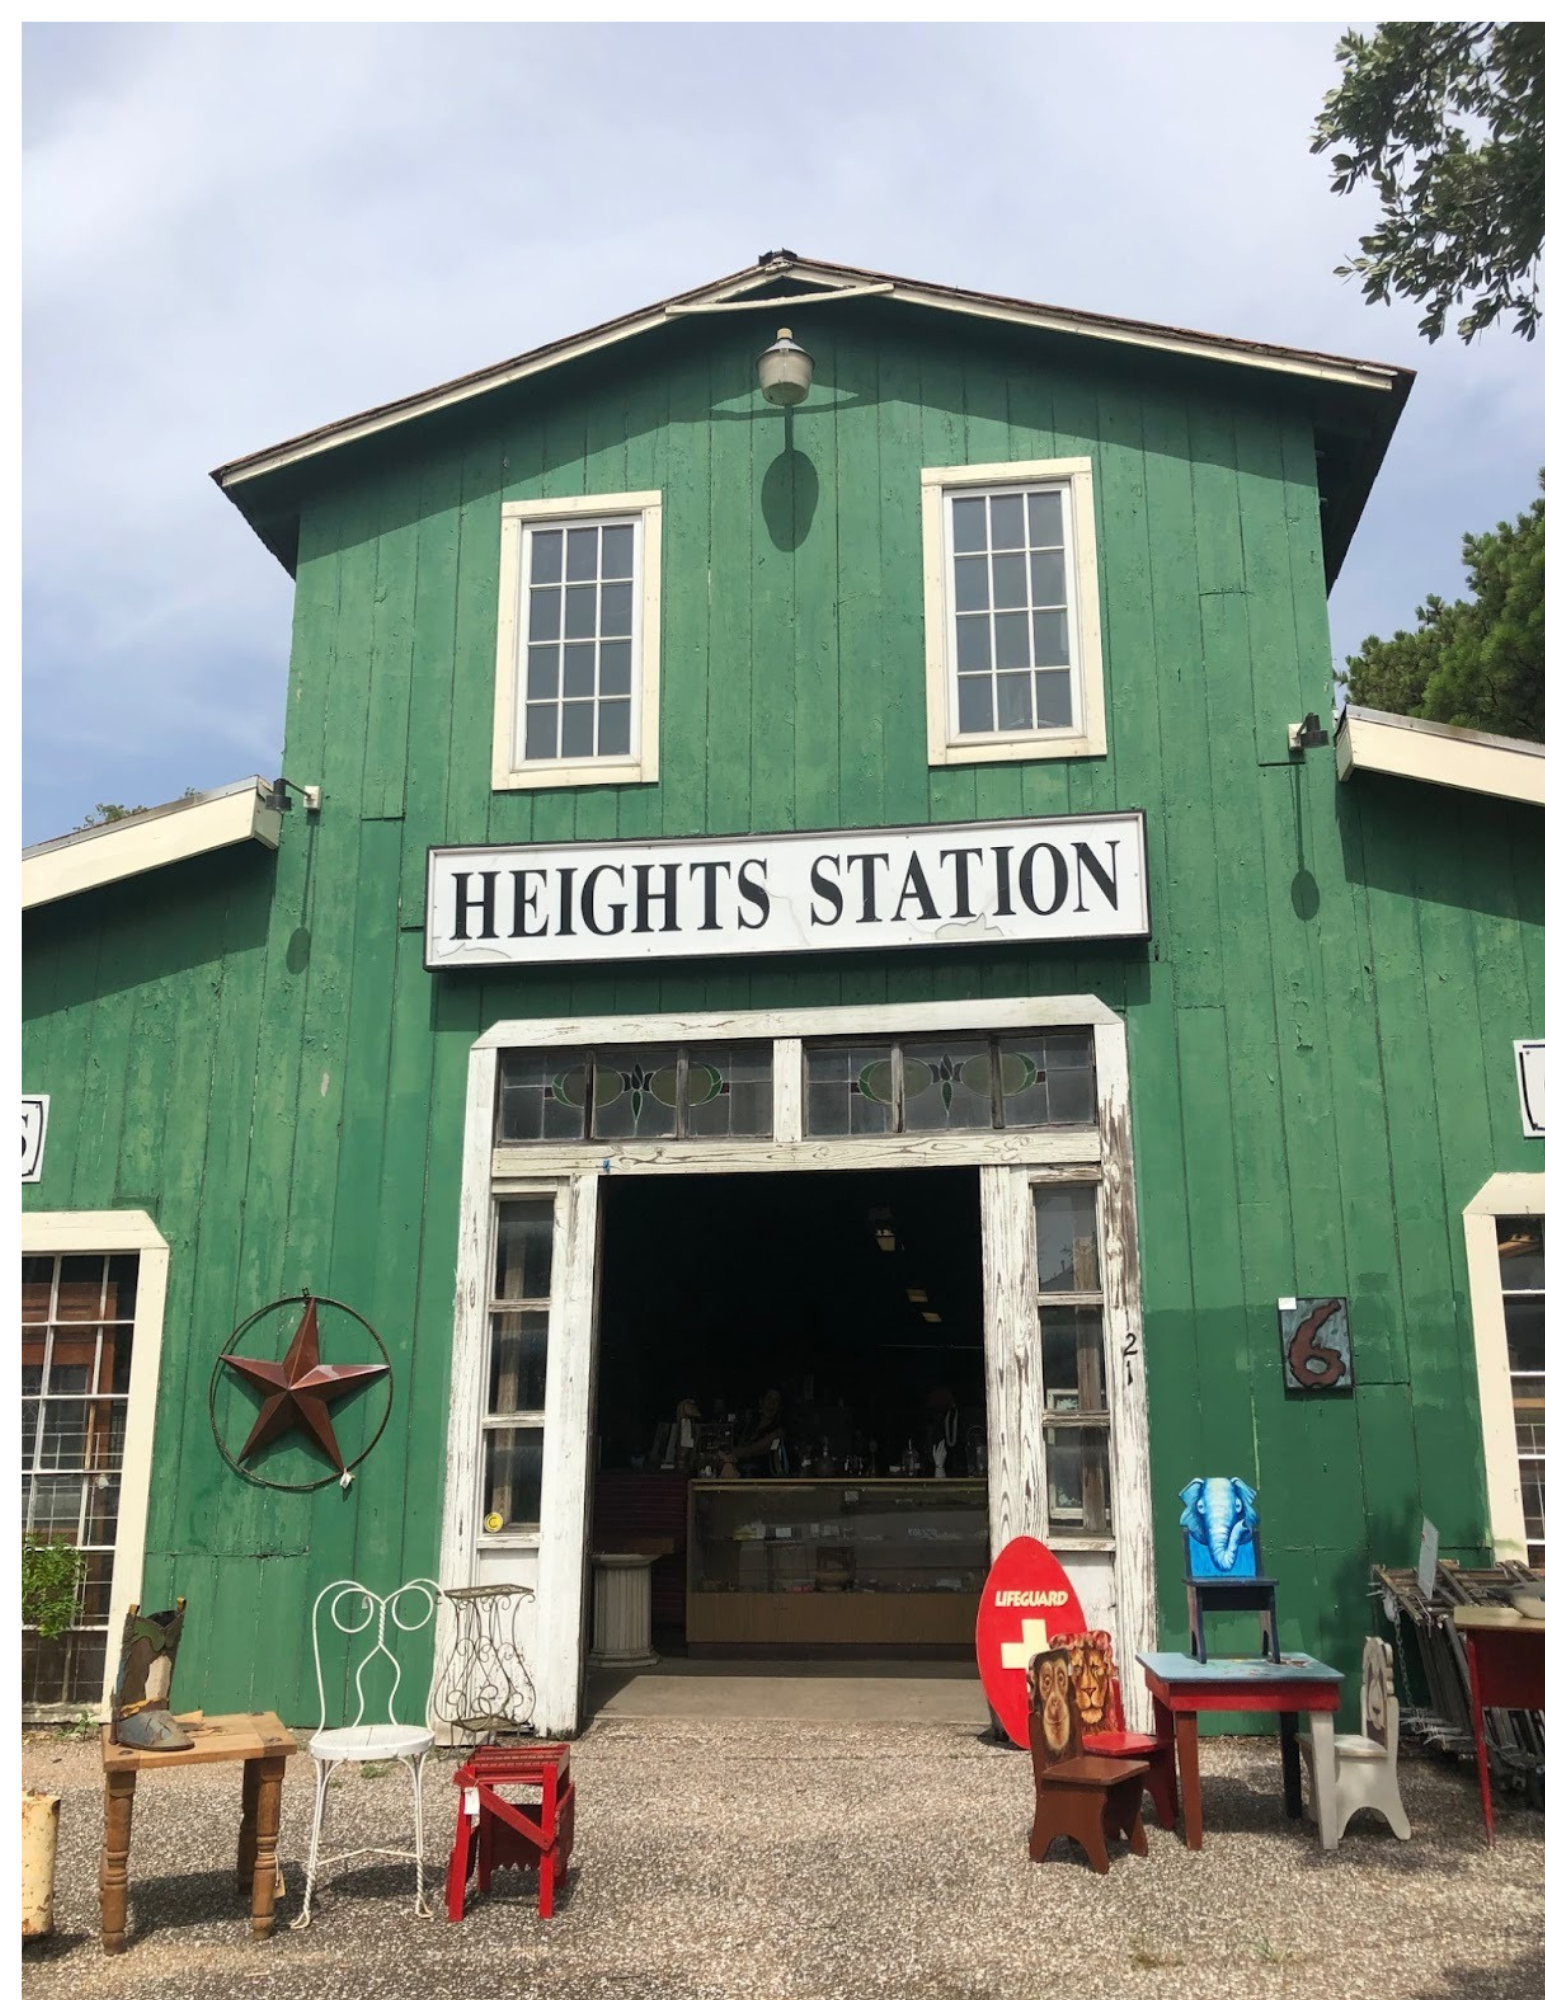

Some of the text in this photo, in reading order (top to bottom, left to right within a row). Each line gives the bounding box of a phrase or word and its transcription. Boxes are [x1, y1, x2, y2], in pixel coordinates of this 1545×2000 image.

[449, 840, 1121, 941] HEIGHTS STATION
[1288, 1299, 1346, 1388] 6
[995, 1591, 1068, 1607] LIFEGUARD
